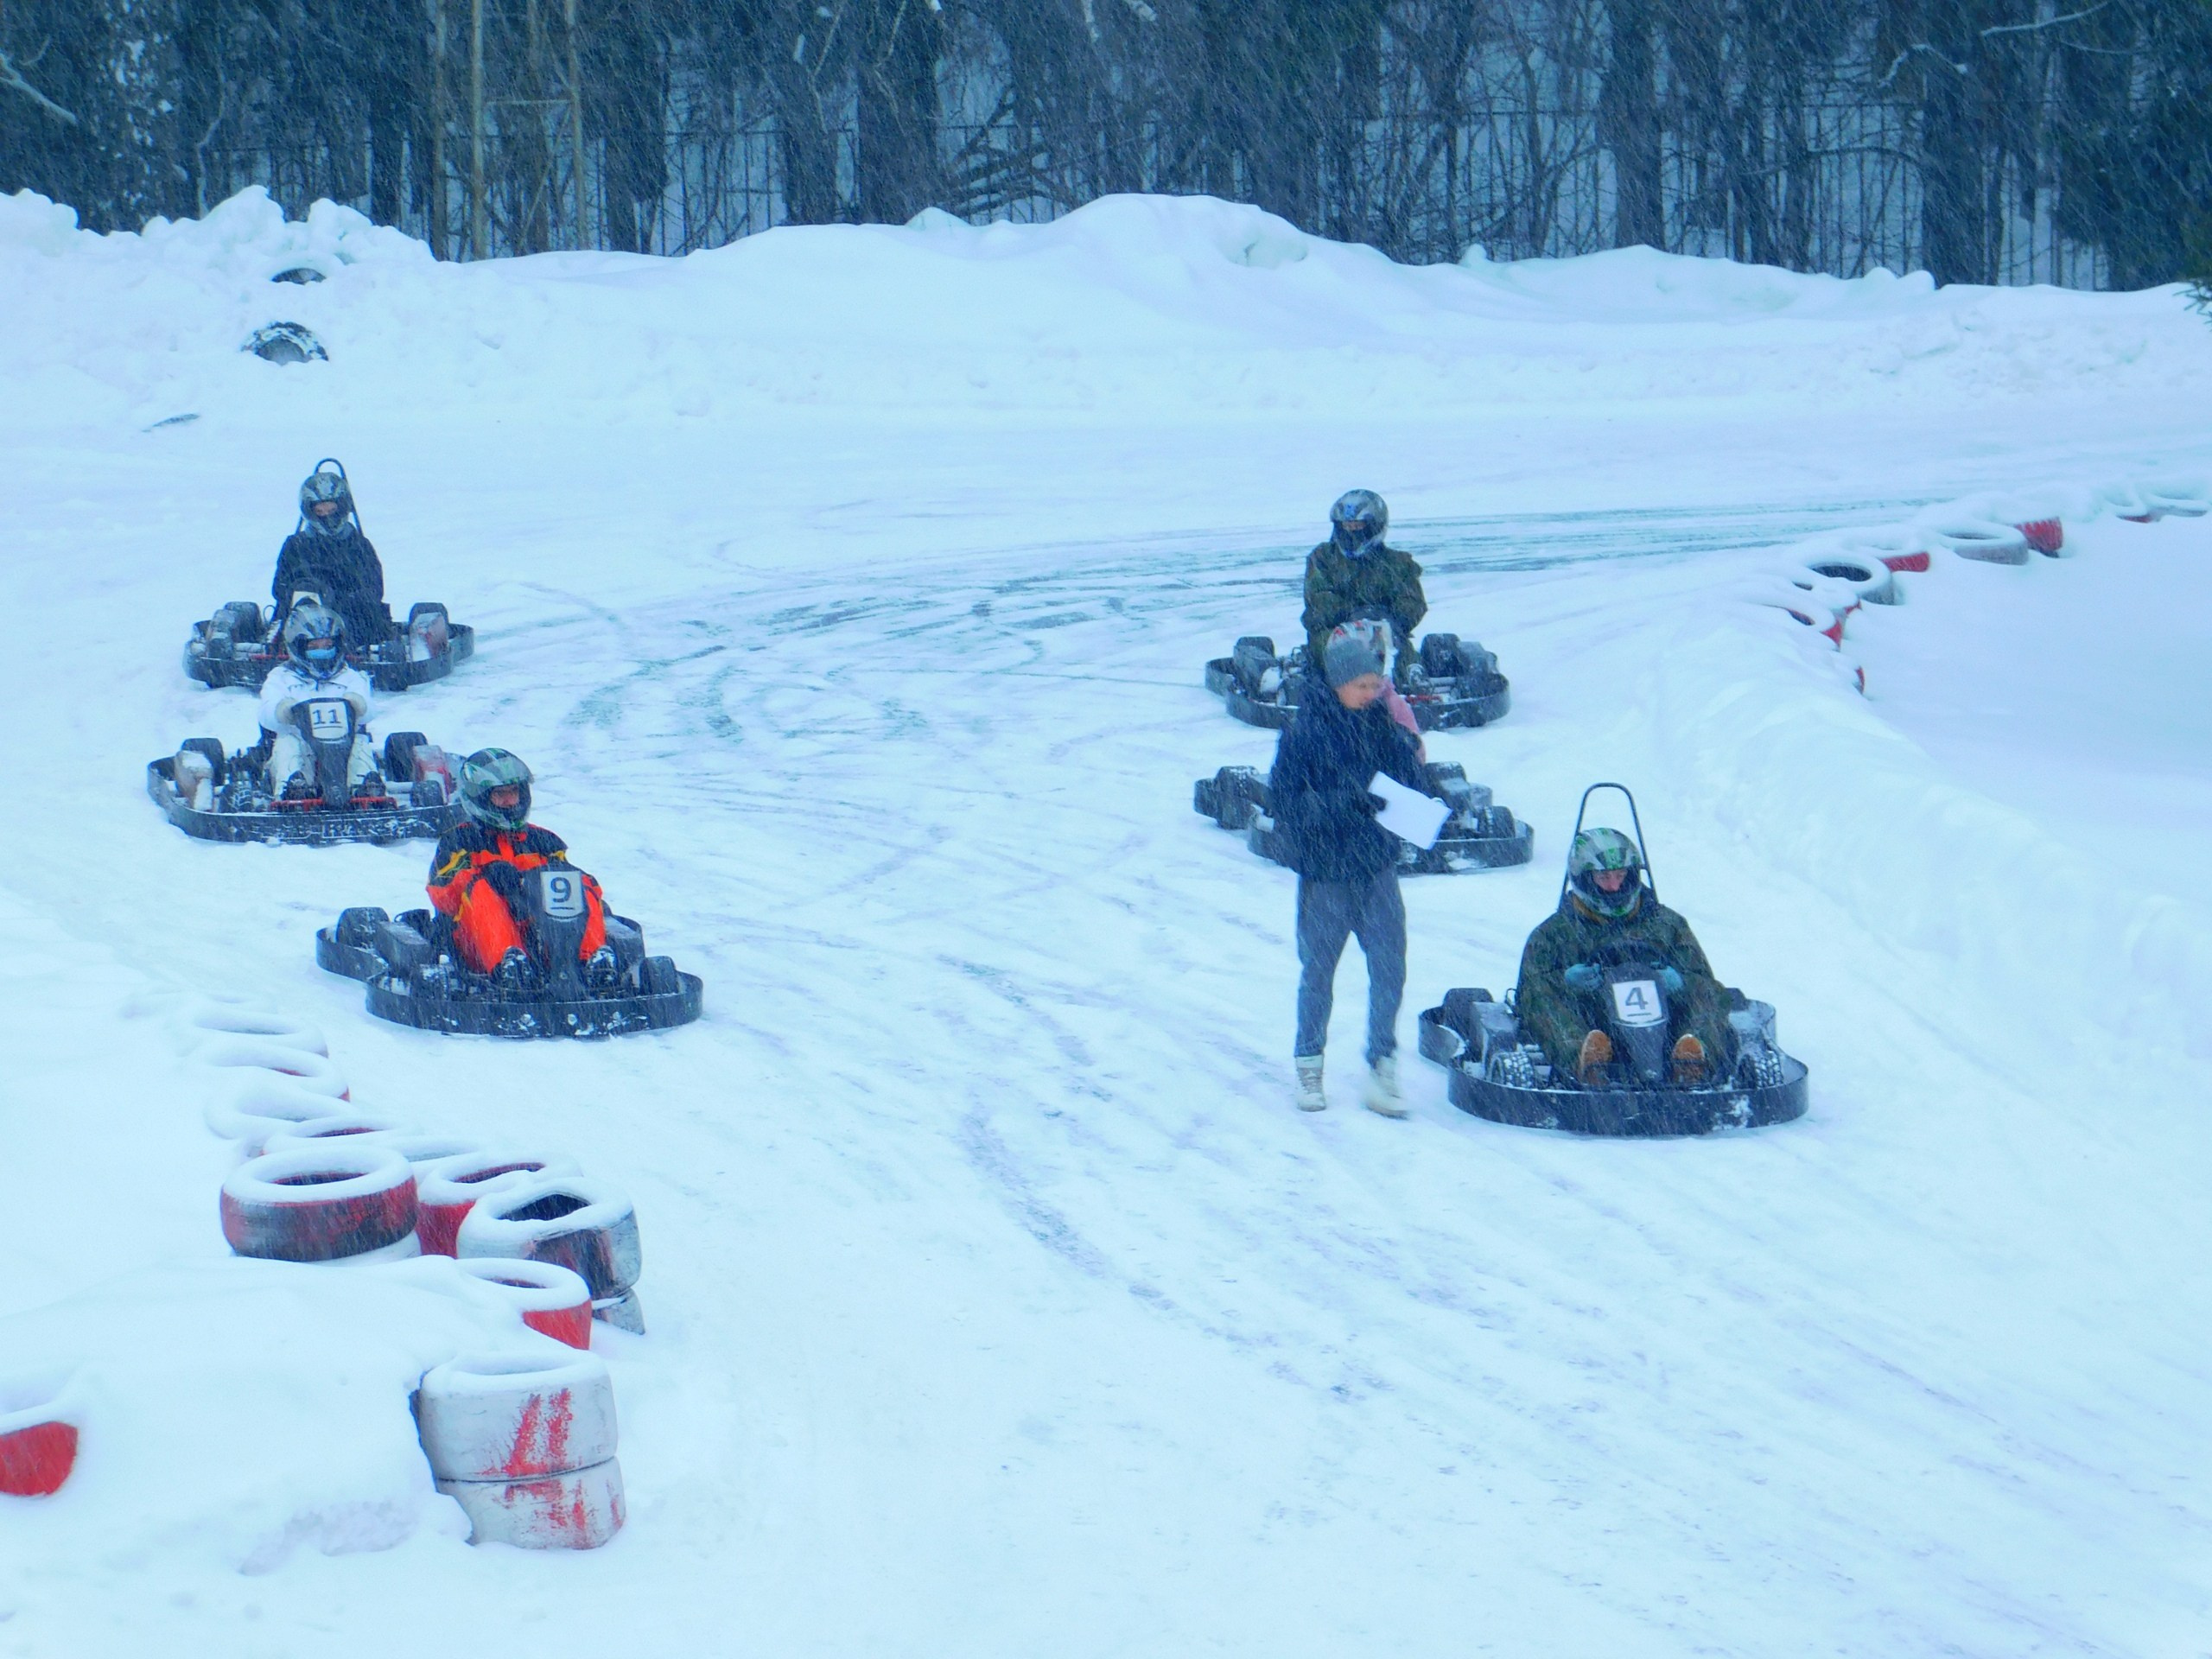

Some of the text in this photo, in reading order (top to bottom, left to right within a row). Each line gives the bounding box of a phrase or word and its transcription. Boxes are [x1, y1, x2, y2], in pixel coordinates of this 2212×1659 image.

[312, 709, 341, 725] 11
[550, 876, 571, 903] 9
[1625, 987, 1648, 1010] 4
